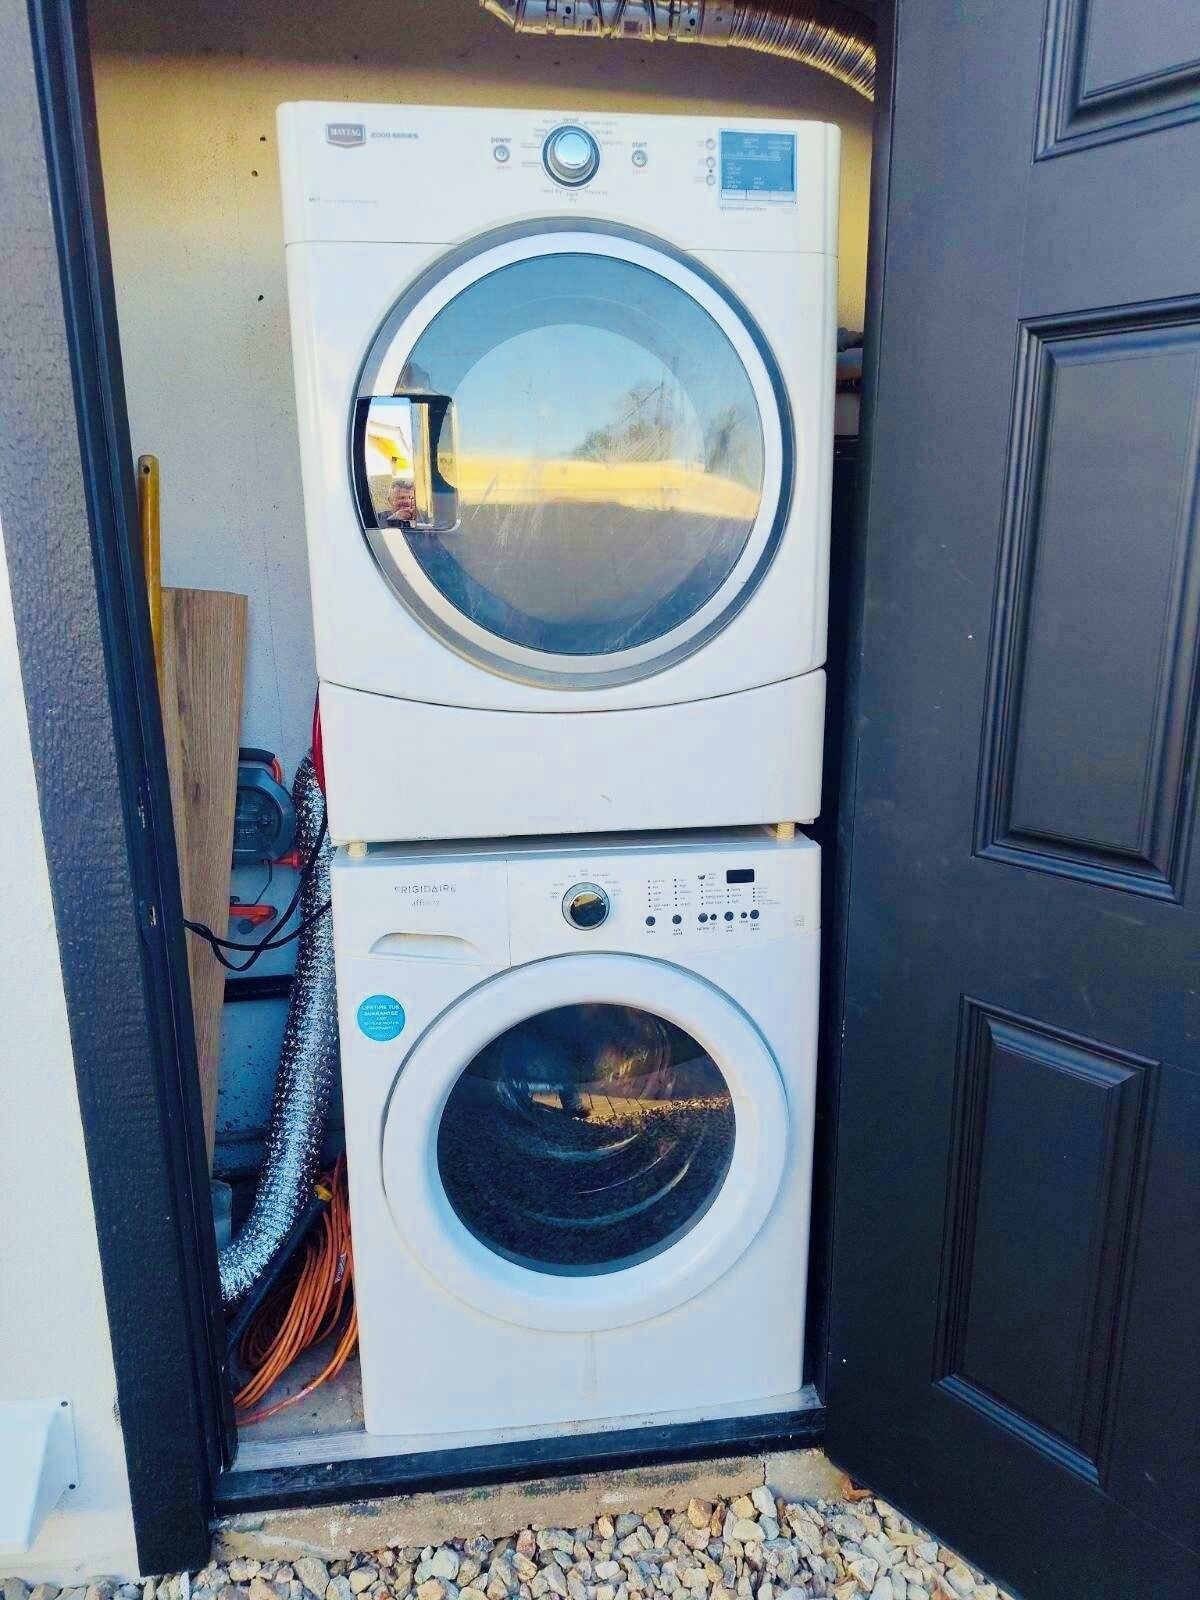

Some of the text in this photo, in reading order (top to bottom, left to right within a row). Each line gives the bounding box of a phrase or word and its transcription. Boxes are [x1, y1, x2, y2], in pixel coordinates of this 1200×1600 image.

[330, 128, 362, 137] MAYTAG
[490, 136, 512, 144] power
[394, 884, 457, 894] FRIGIDAIRE
[411, 898, 441, 908] affinity
